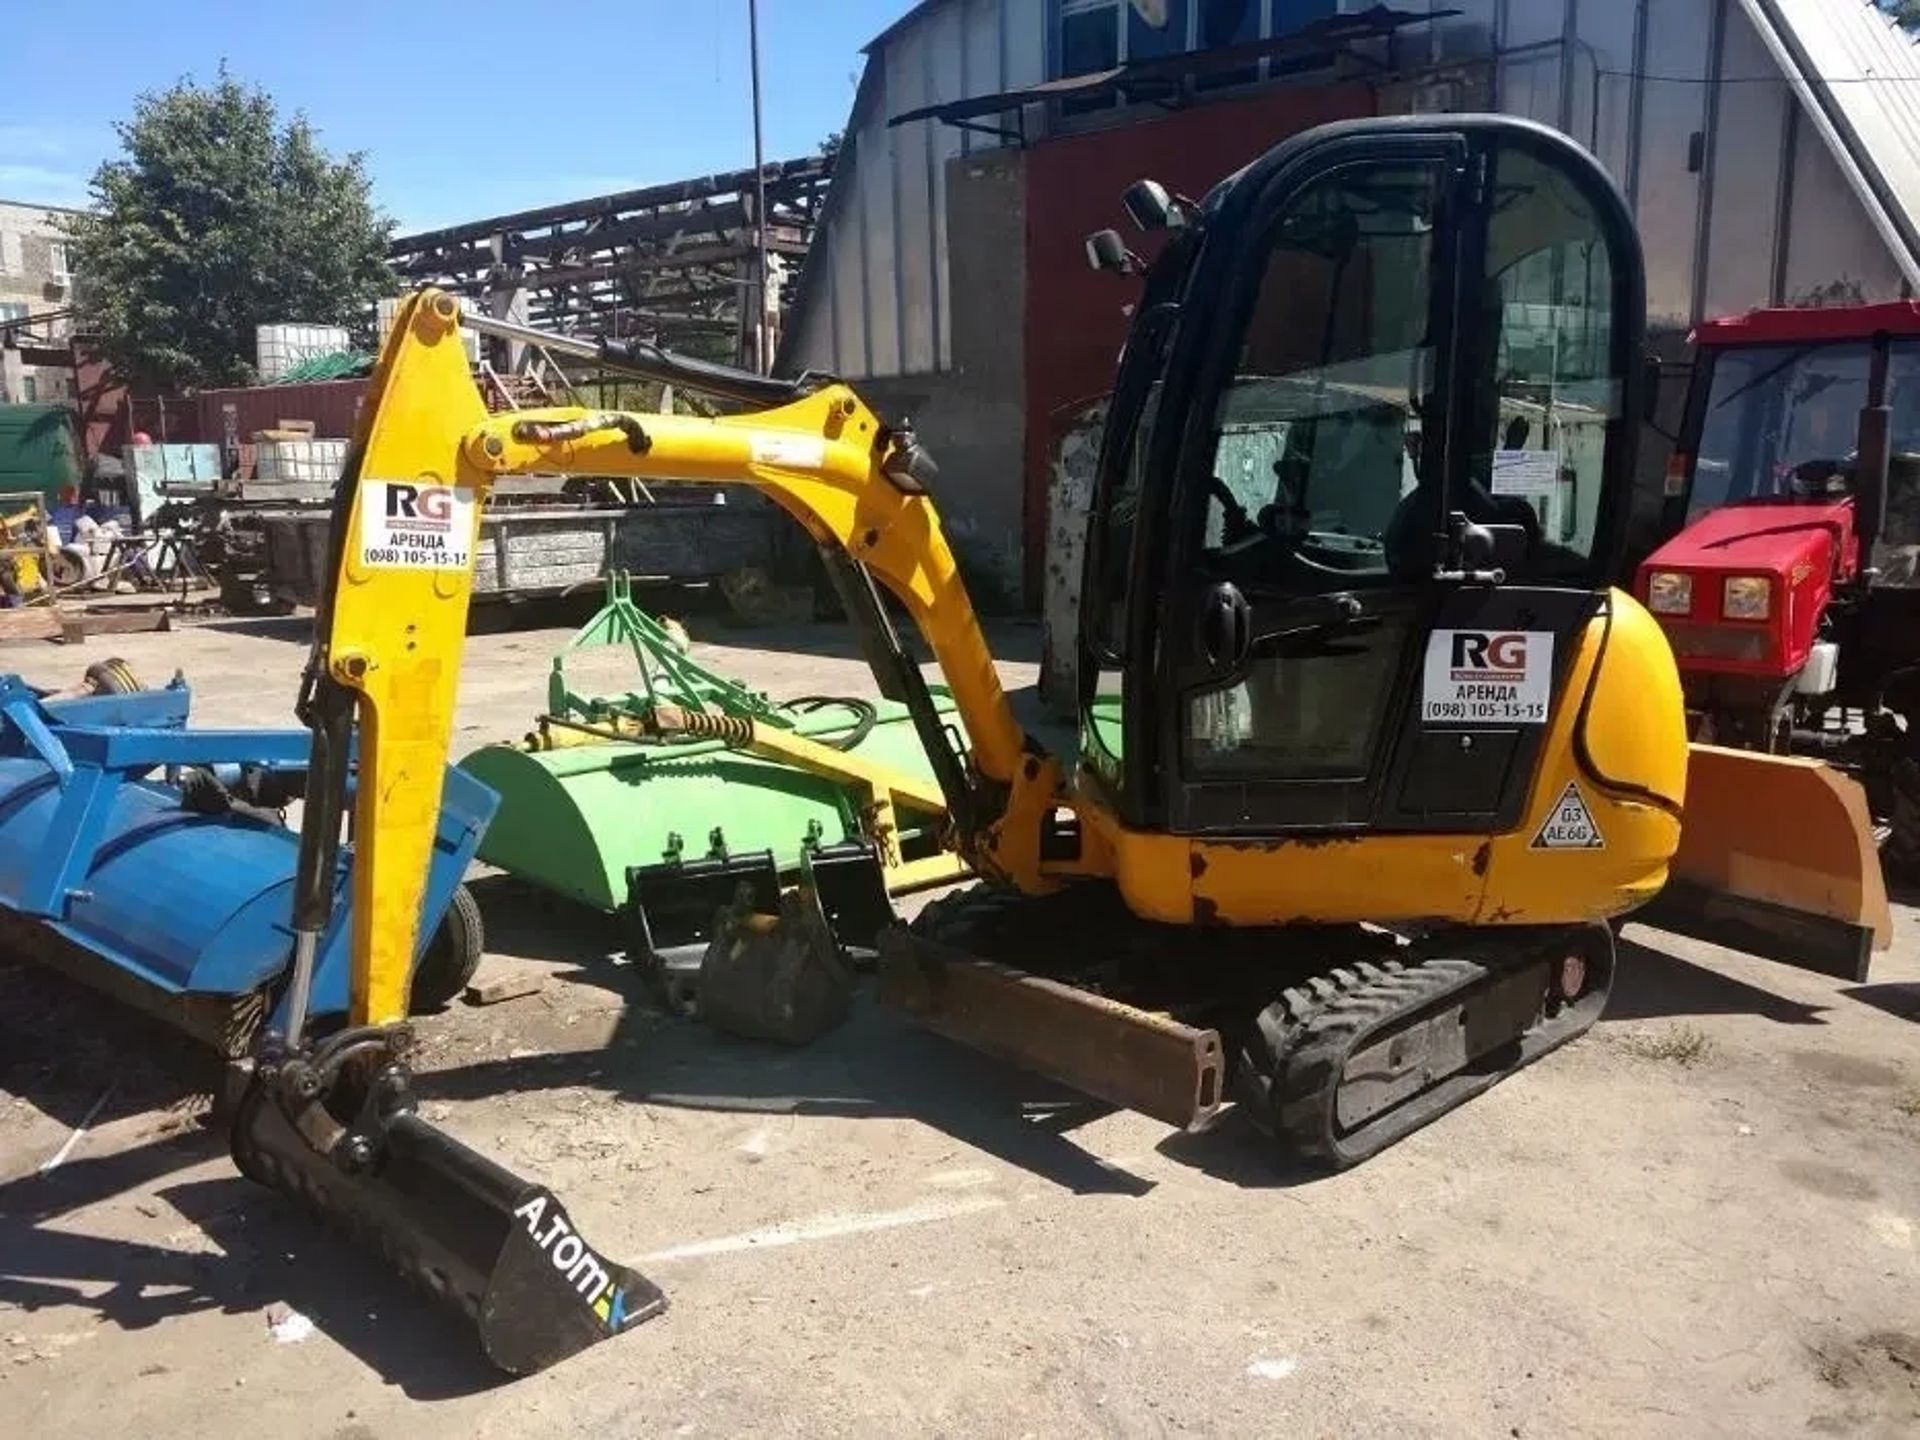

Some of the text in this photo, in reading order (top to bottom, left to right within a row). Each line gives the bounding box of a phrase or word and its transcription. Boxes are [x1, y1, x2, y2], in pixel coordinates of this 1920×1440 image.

[386, 483, 451, 520] RG
[390, 533, 445, 549] АРЕНДА
[365, 549, 399, 563] (098)
[1451, 633, 1526, 669] RG
[1456, 685, 1517, 702] АРЕНДА
[1427, 701, 1544, 718] (098) 105-15-15
